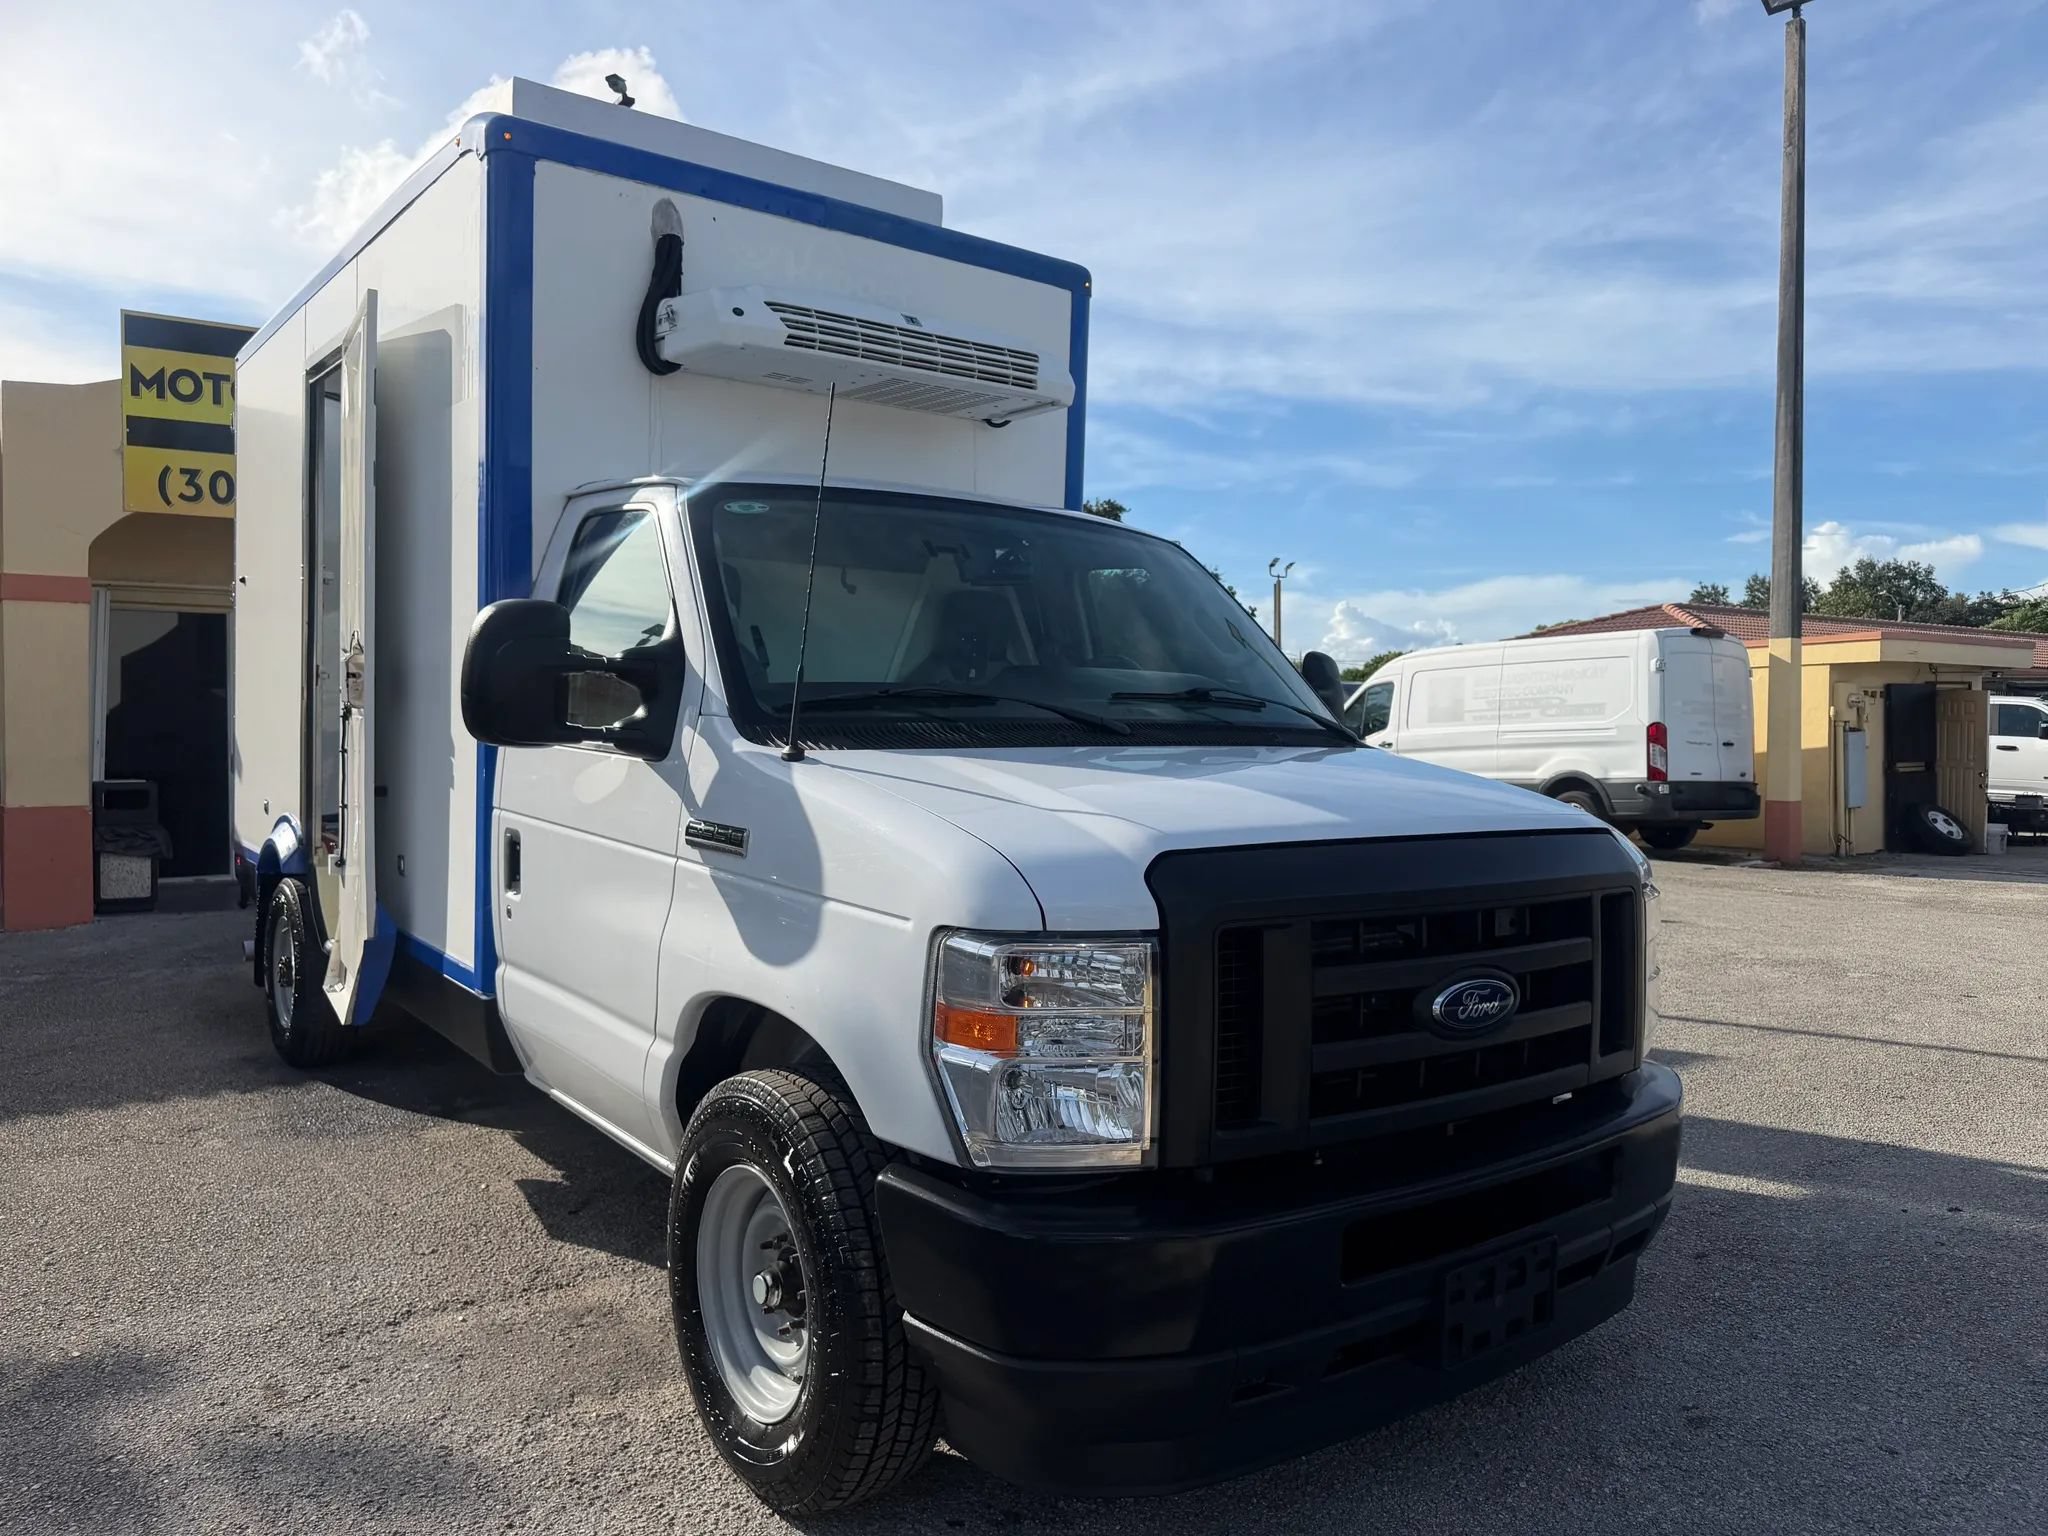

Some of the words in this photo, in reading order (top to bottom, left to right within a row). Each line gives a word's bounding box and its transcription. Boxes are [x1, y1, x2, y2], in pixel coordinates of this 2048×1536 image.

[130, 362, 236, 407] MOT
[158, 464, 235, 507] (30
[1458, 988, 1502, 1020] Ford
